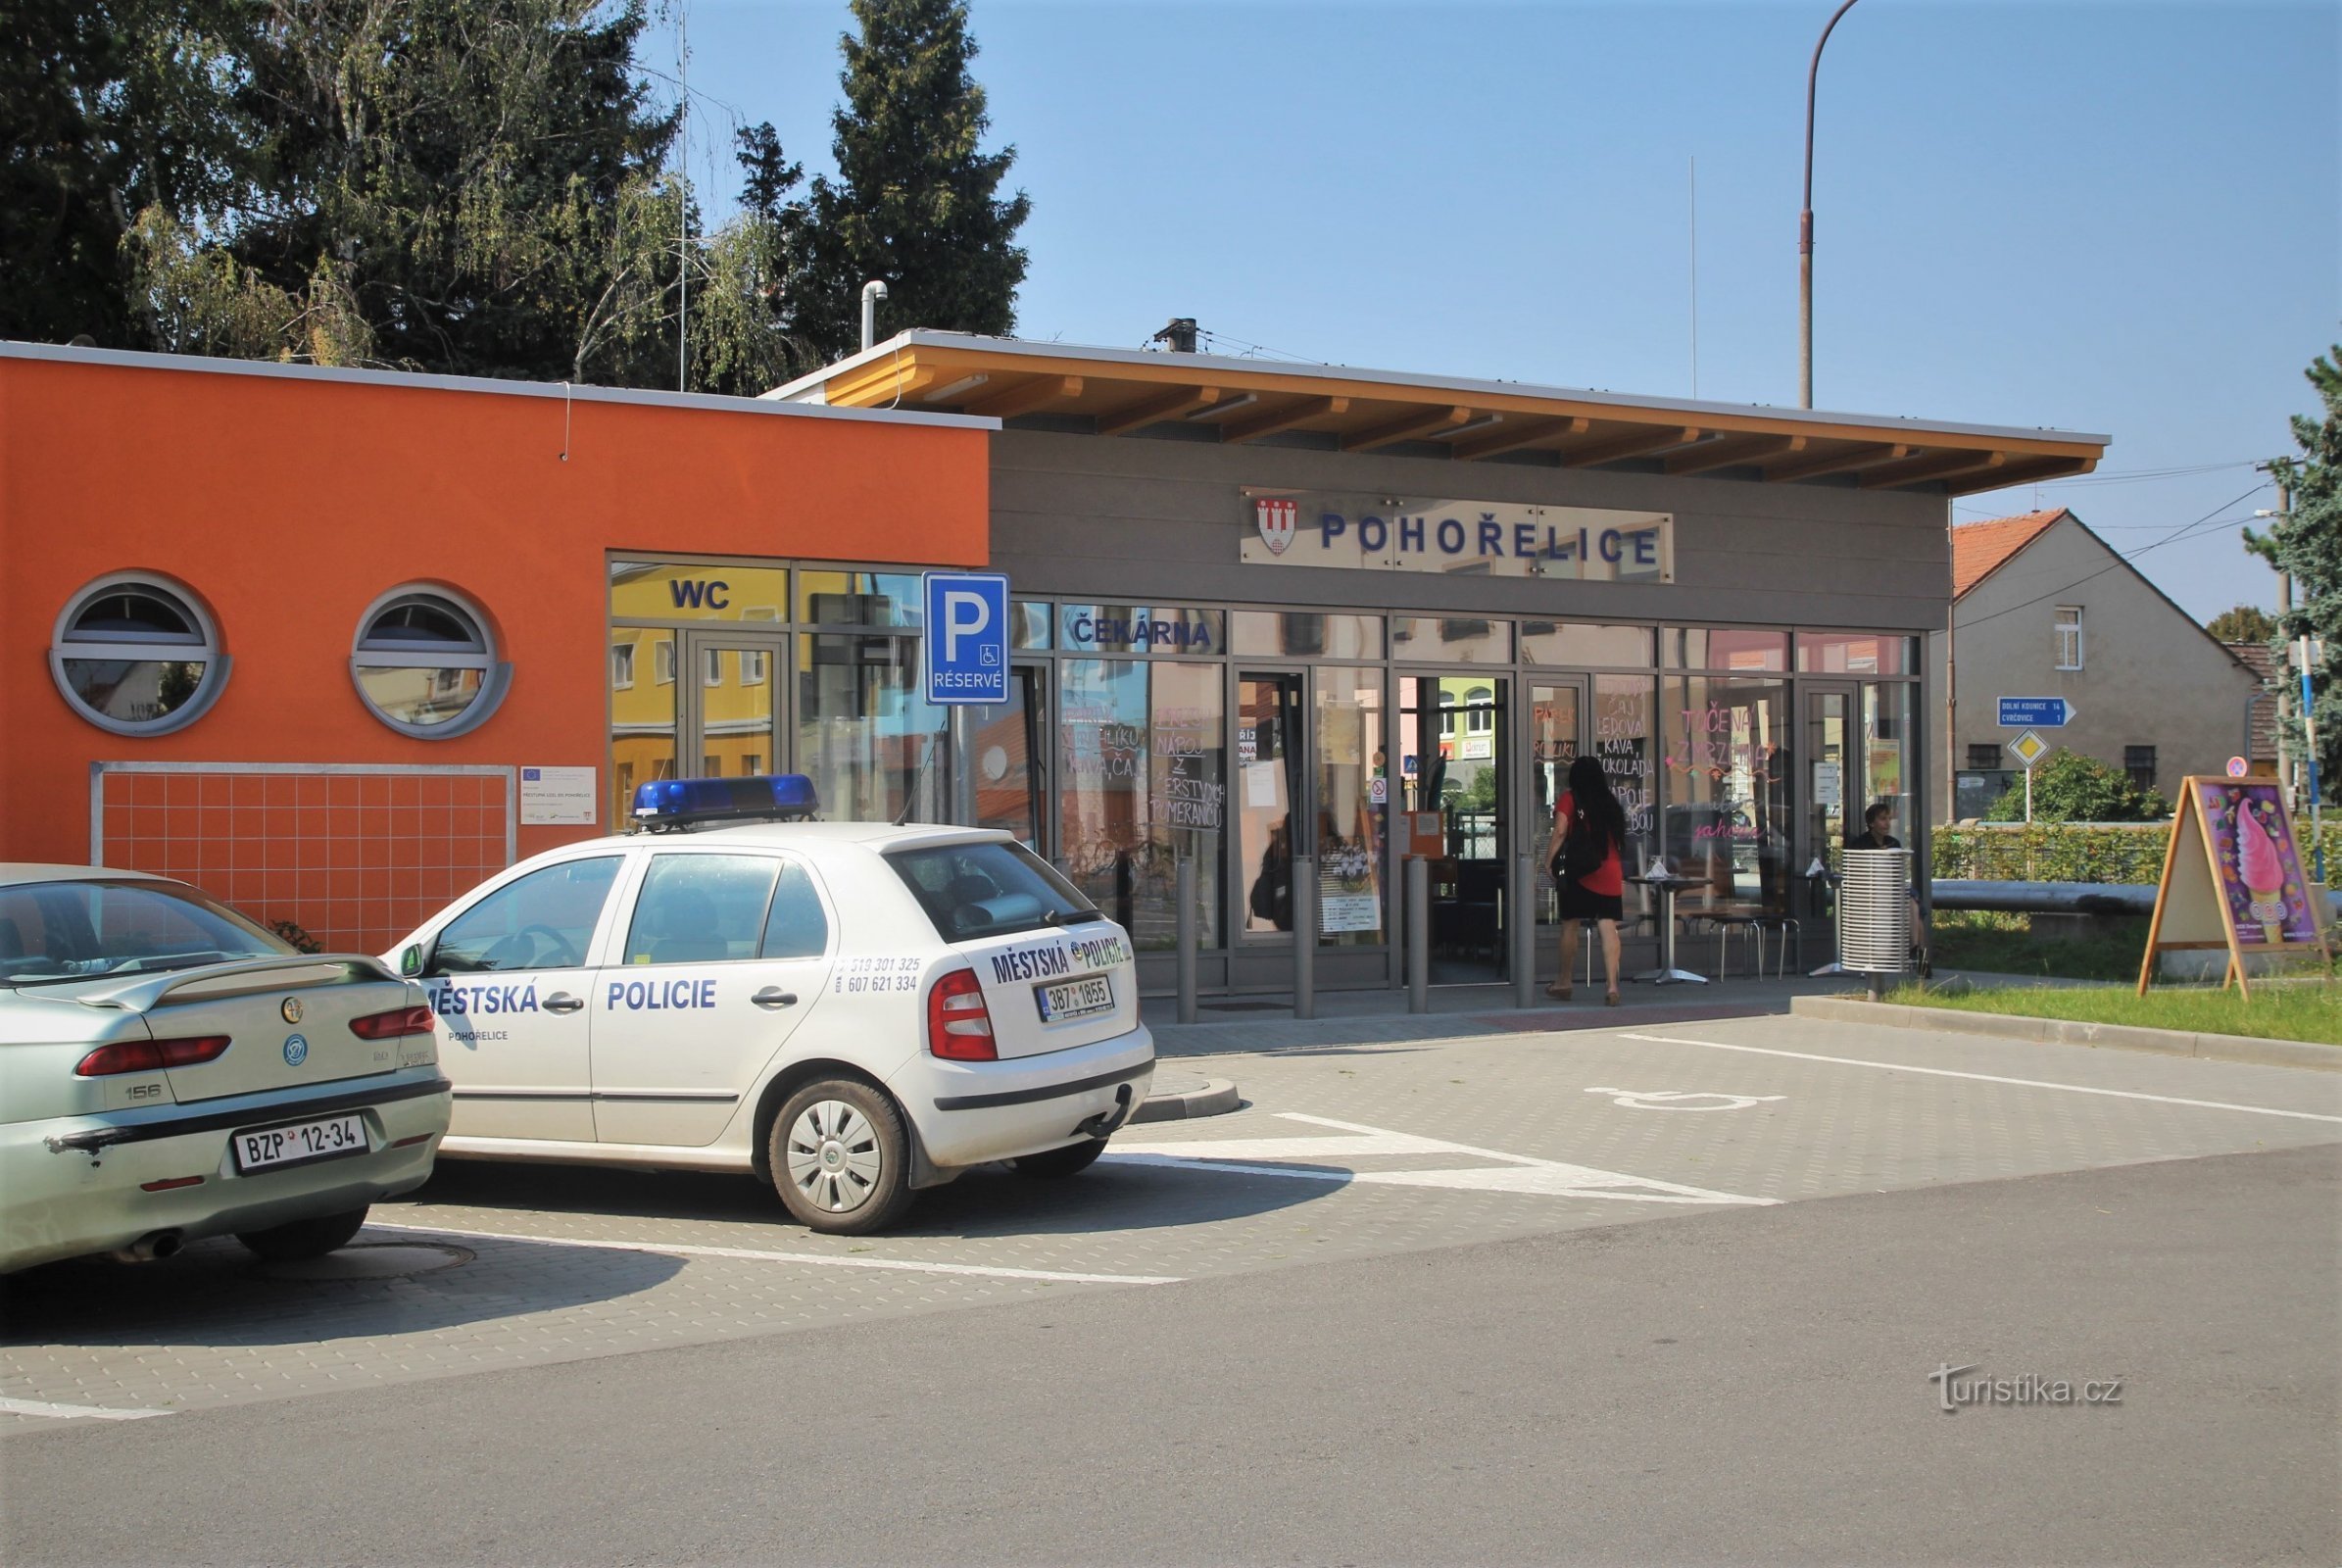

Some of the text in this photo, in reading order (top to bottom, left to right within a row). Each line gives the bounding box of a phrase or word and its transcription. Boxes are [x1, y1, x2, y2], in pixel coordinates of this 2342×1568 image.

[1320, 512, 1657, 566] POHOŘELICE
[670, 579, 730, 611] WC
[944, 591, 990, 662] P
[1073, 612, 1211, 646] ČEKÁRNA
[933, 669, 1003, 690] RÉSERVÉ
[2001, 702, 2020, 710] DOLNÍ
[2001, 713, 2034, 722] CVRČOVICE
[1156, 731, 1204, 756] NÁPOJ
[1596, 752, 1655, 778] OKOLÁDA
[1608, 779, 1653, 808] ÁPOJE
[1149, 801, 1223, 829] POMERANČŮ
[851, 956, 921, 972] 519 301 325
[991, 939, 1070, 985] MĚSTSKÁ
[1081, 937, 1125, 969] POLICIE
[607, 979, 717, 1010] POLICIE
[848, 975, 917, 993] 607 621 334
[1049, 987, 1071, 1011] 3B7
[1078, 980, 1107, 1005] 1855
[448, 1028, 509, 1042] POHOŘELICE
[125, 1083, 163, 1101] 156
[247, 1120, 357, 1164] BZP 12-34
